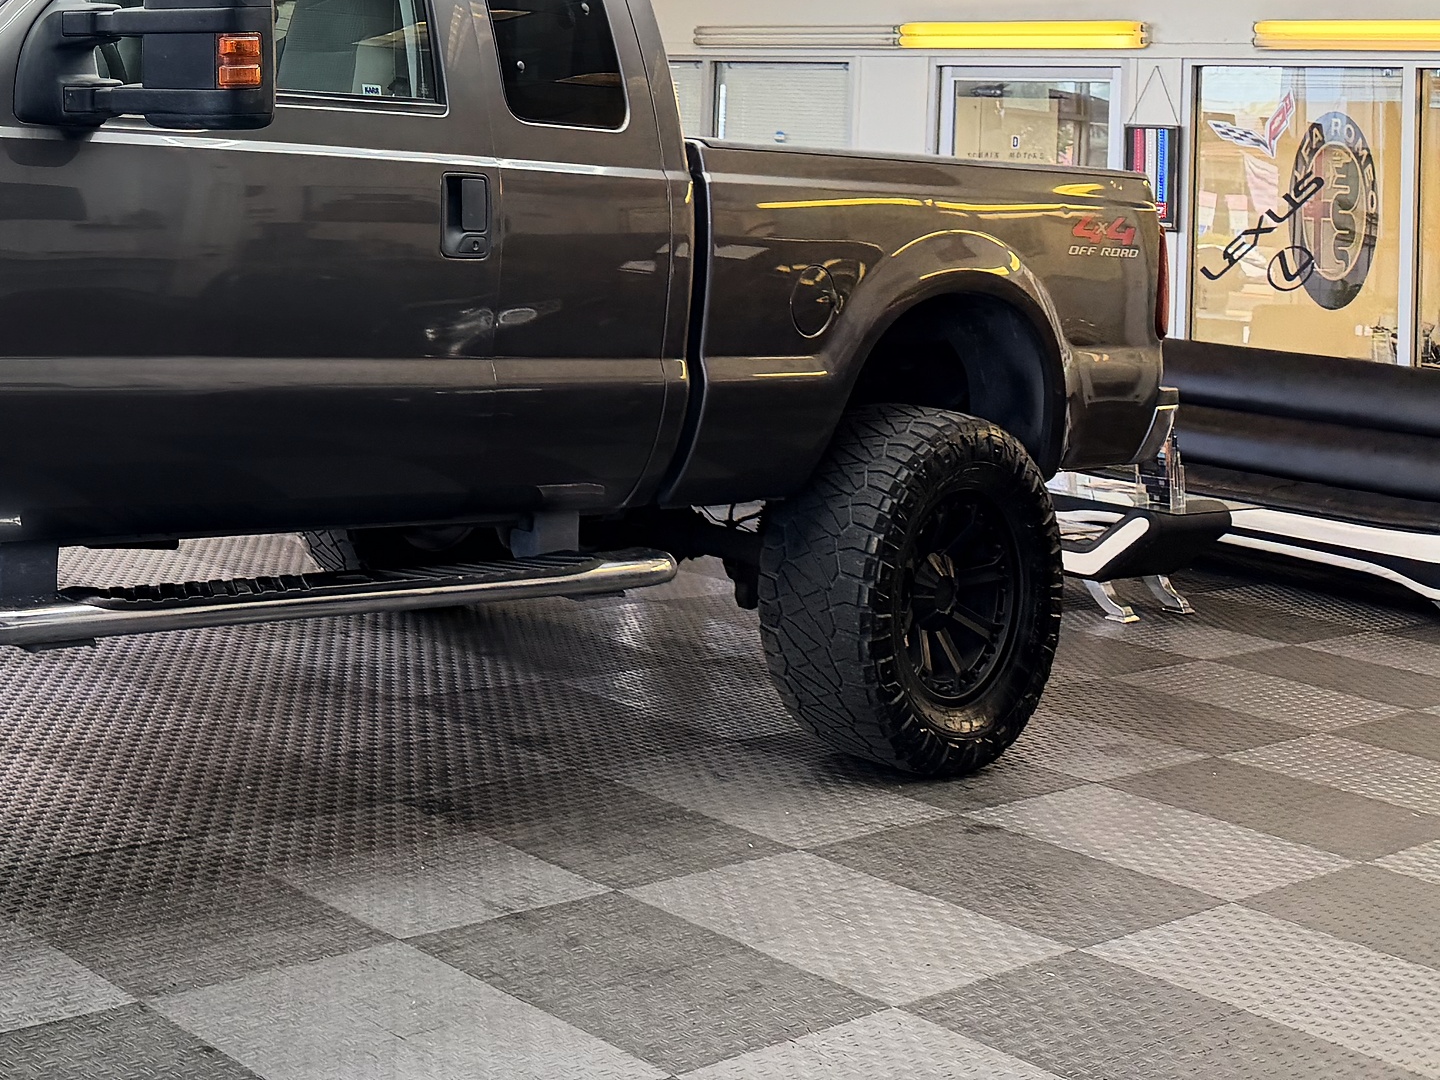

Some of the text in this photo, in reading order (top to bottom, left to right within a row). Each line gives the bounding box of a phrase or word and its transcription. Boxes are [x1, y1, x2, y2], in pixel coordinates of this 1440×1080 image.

[1330, 117, 1377, 214] ROMEO
[1068, 245, 1140, 259] OFF ROAD
[1200, 171, 1325, 281] LEXUS
